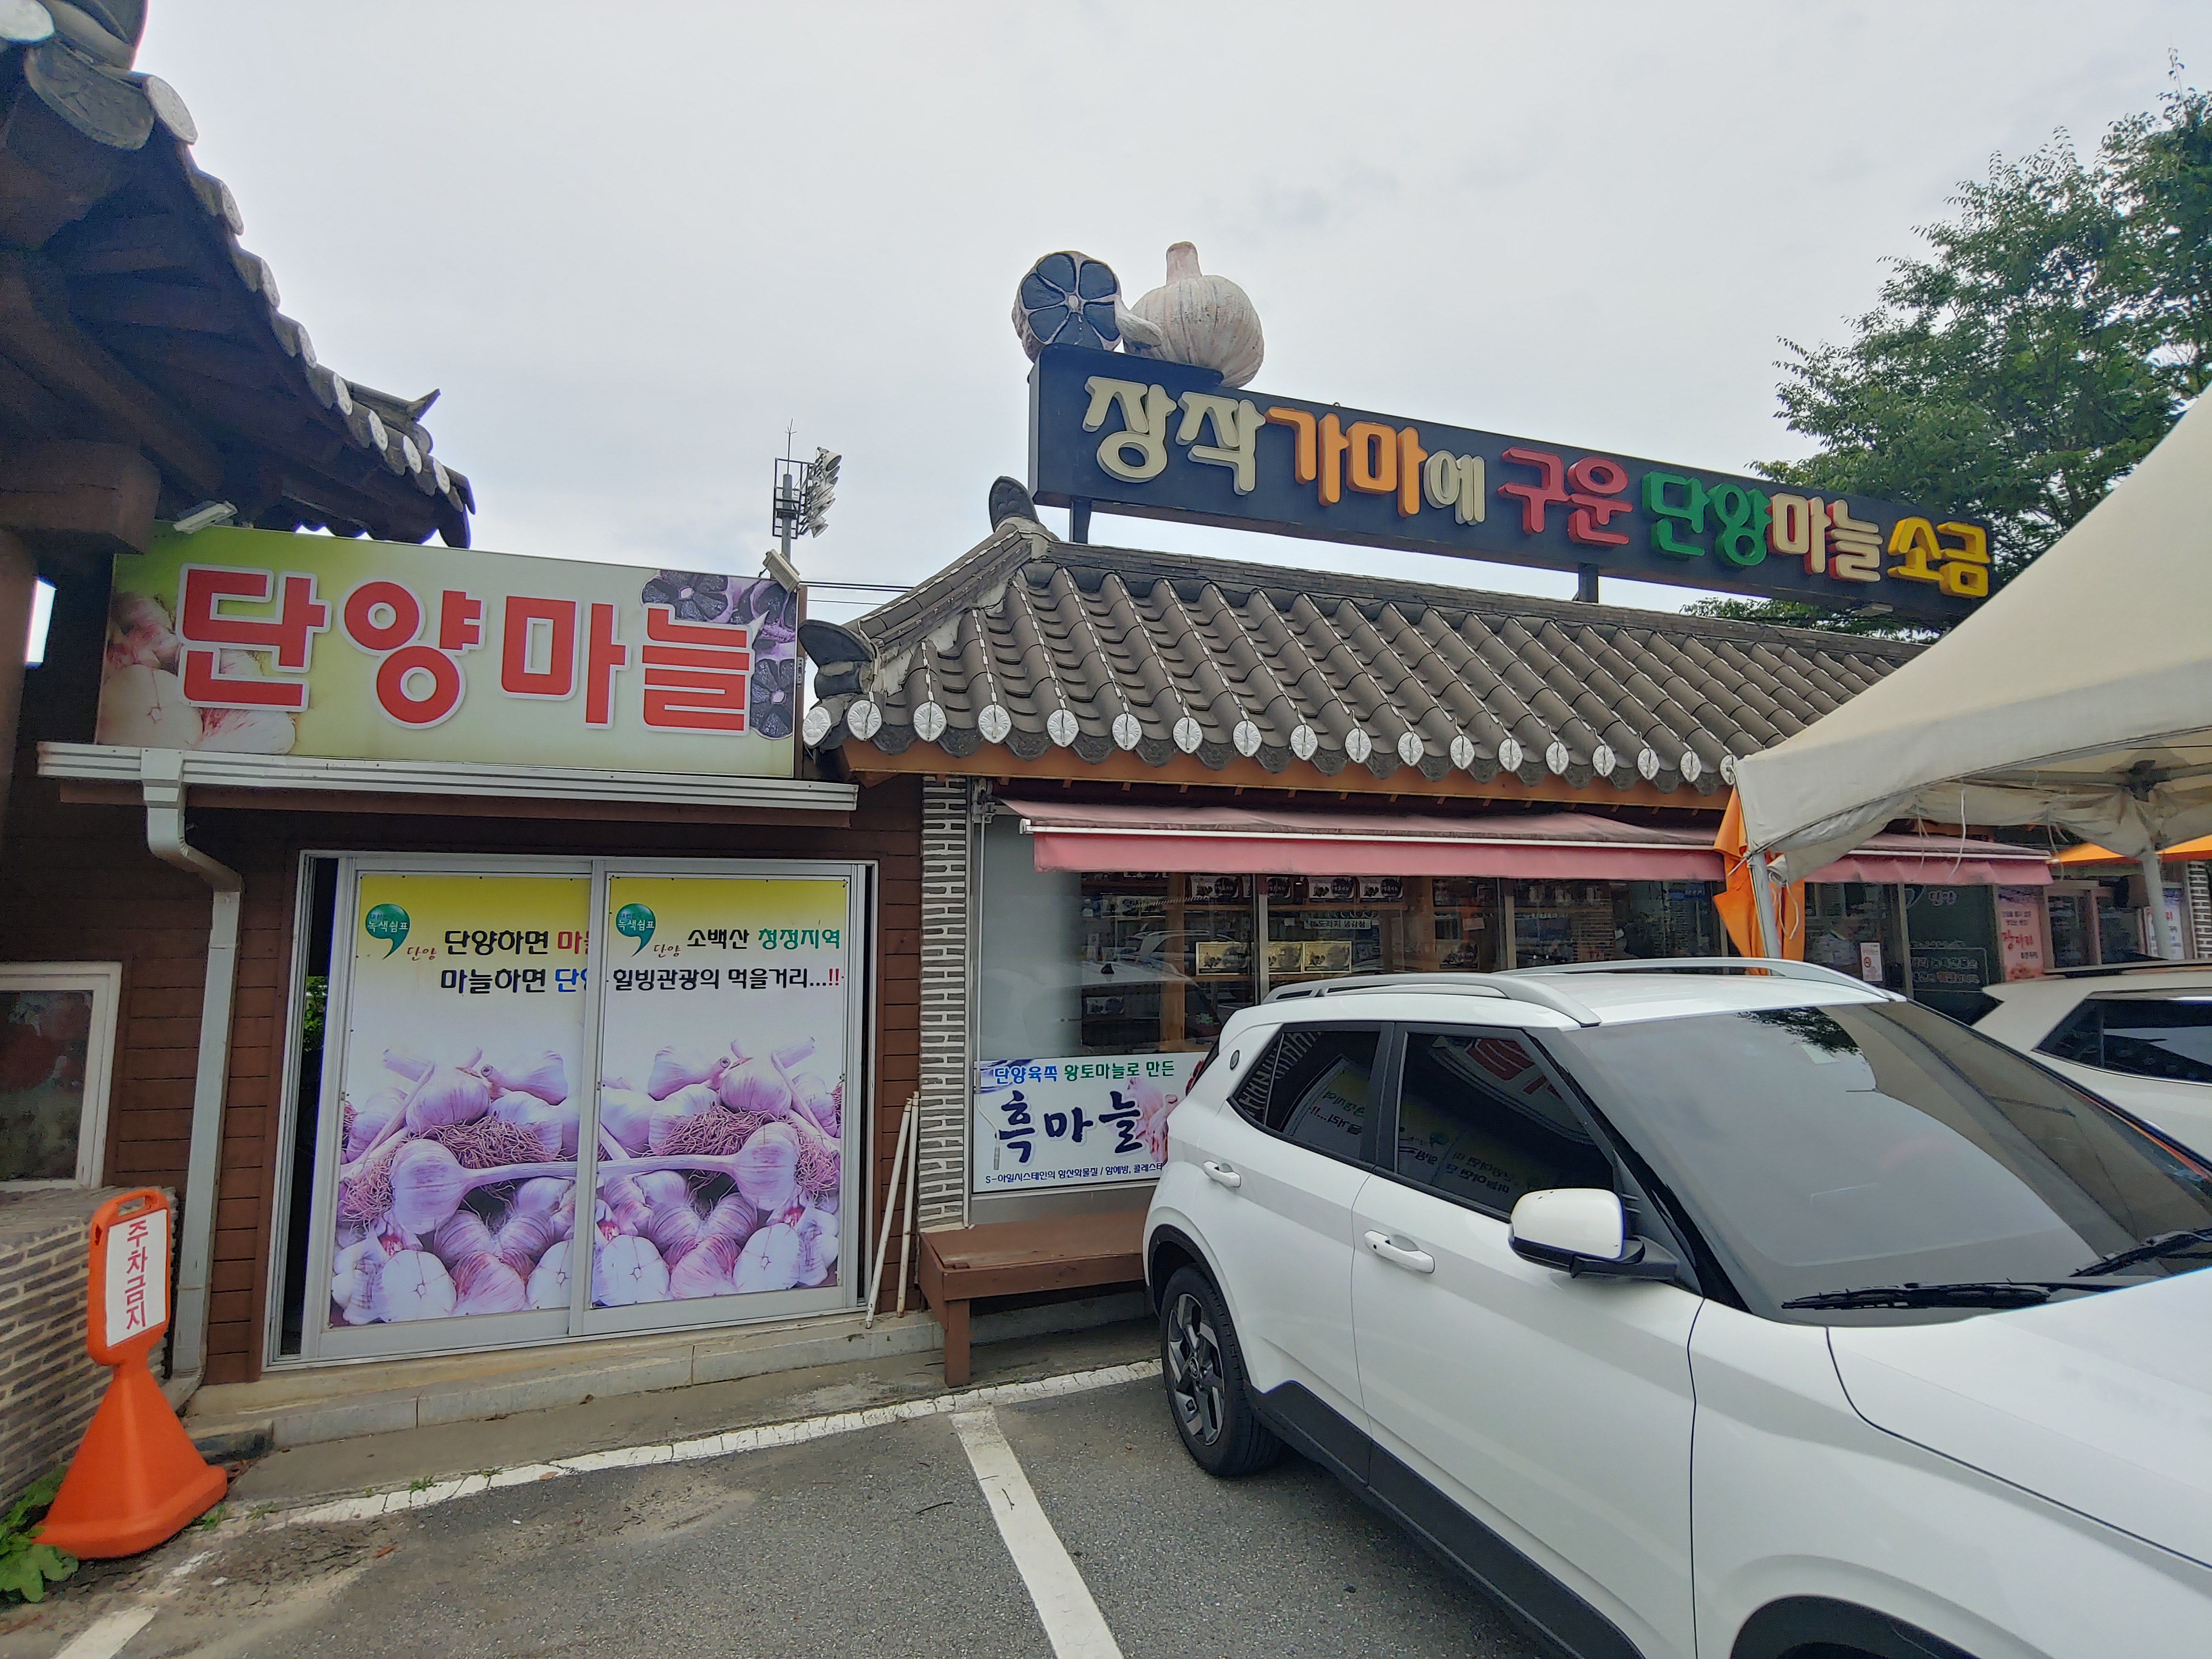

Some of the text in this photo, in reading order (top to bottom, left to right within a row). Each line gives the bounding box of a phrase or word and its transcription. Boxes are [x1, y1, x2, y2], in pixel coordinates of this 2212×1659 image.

[180, 563, 754, 735] 단양마늘
[368, 920, 409, 933] 녹색쉼표
[618, 919, 655, 931] 녹색쉼표
[445, 930, 590, 955] 단양하면 마
[686, 928, 840, 950] 소백산 청정지역
[407, 946, 438, 961] 단양
[654, 944, 681, 958] 단양
[441, 968, 546, 994] 마늘하면
[613, 969, 720, 991] 힐빙관광의
[994, 1065, 1058, 1085] 단양육쪽
[1145, 1060, 1175, 1078] 만든
[995, 1090, 1144, 1163] 흑마늘
[124, 1219, 149, 1330] 주차금지
